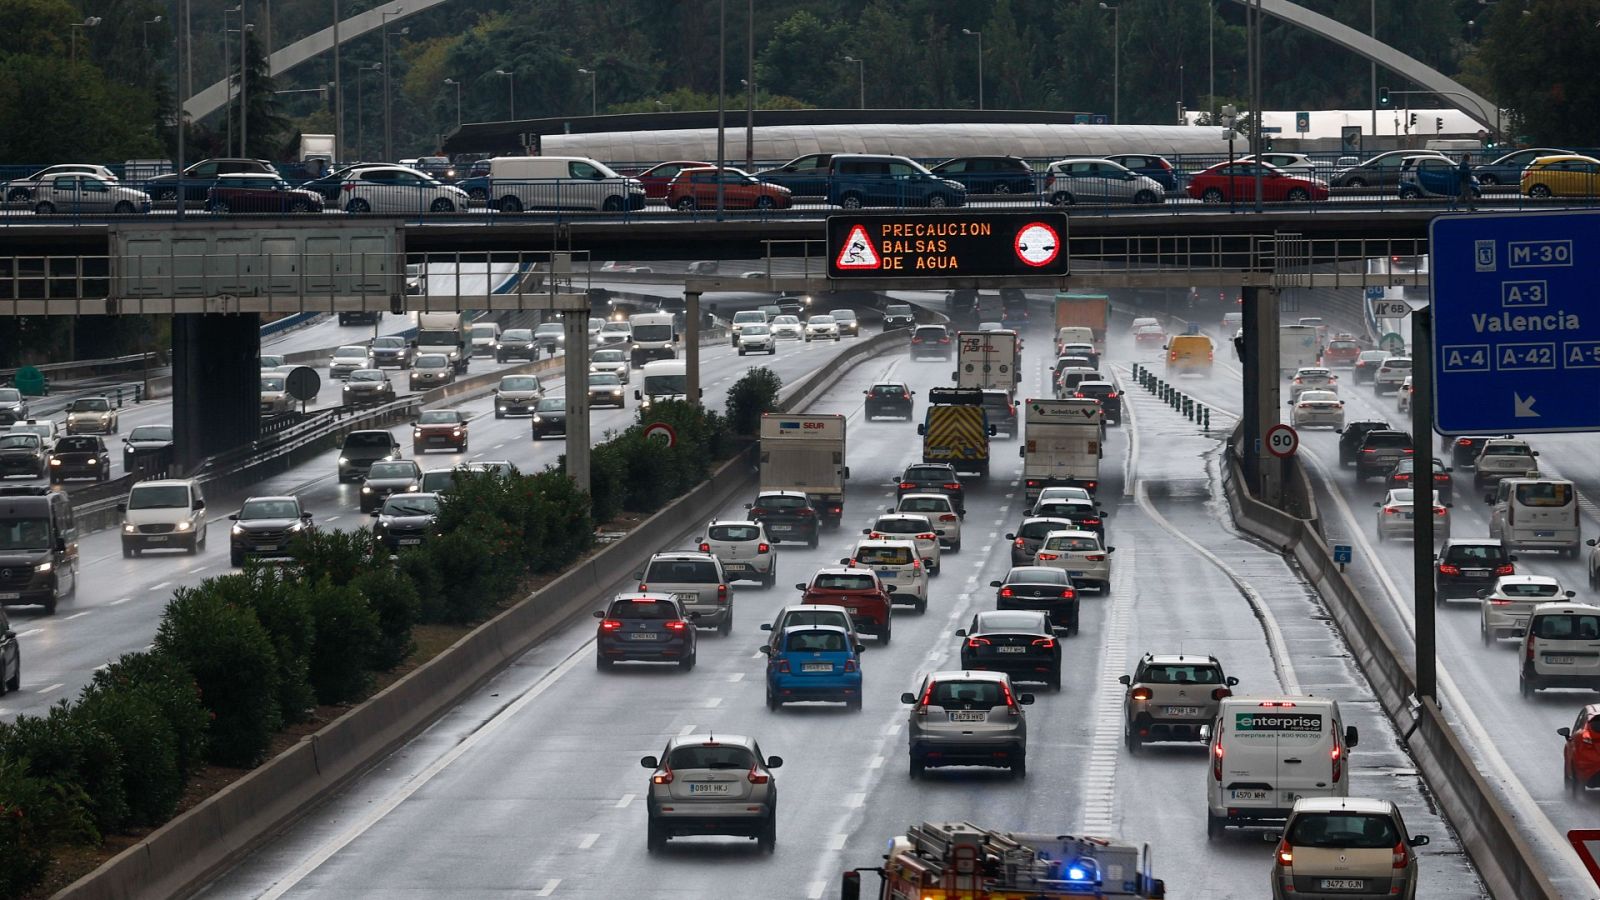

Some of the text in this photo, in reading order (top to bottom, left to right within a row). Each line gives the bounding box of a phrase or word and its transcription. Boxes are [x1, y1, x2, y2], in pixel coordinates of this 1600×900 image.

[882, 223, 991, 237] PRECAUCION
[883, 240, 947, 253] BALSAS
[1514, 246, 1568, 263] M-30
[883, 256, 958, 269] DE AGUA
[1508, 285, 1542, 302] A-3
[1391, 304, 1404, 313] 6B
[1472, 310, 1580, 332] Valencia
[1448, 346, 1600, 366] A-4 A-42 A-5
[1272, 435, 1292, 446] 90
[1240, 716, 1320, 728] enterprise
[1236, 791, 1252, 799] 4570
[1327, 880, 1344, 888] 3472
